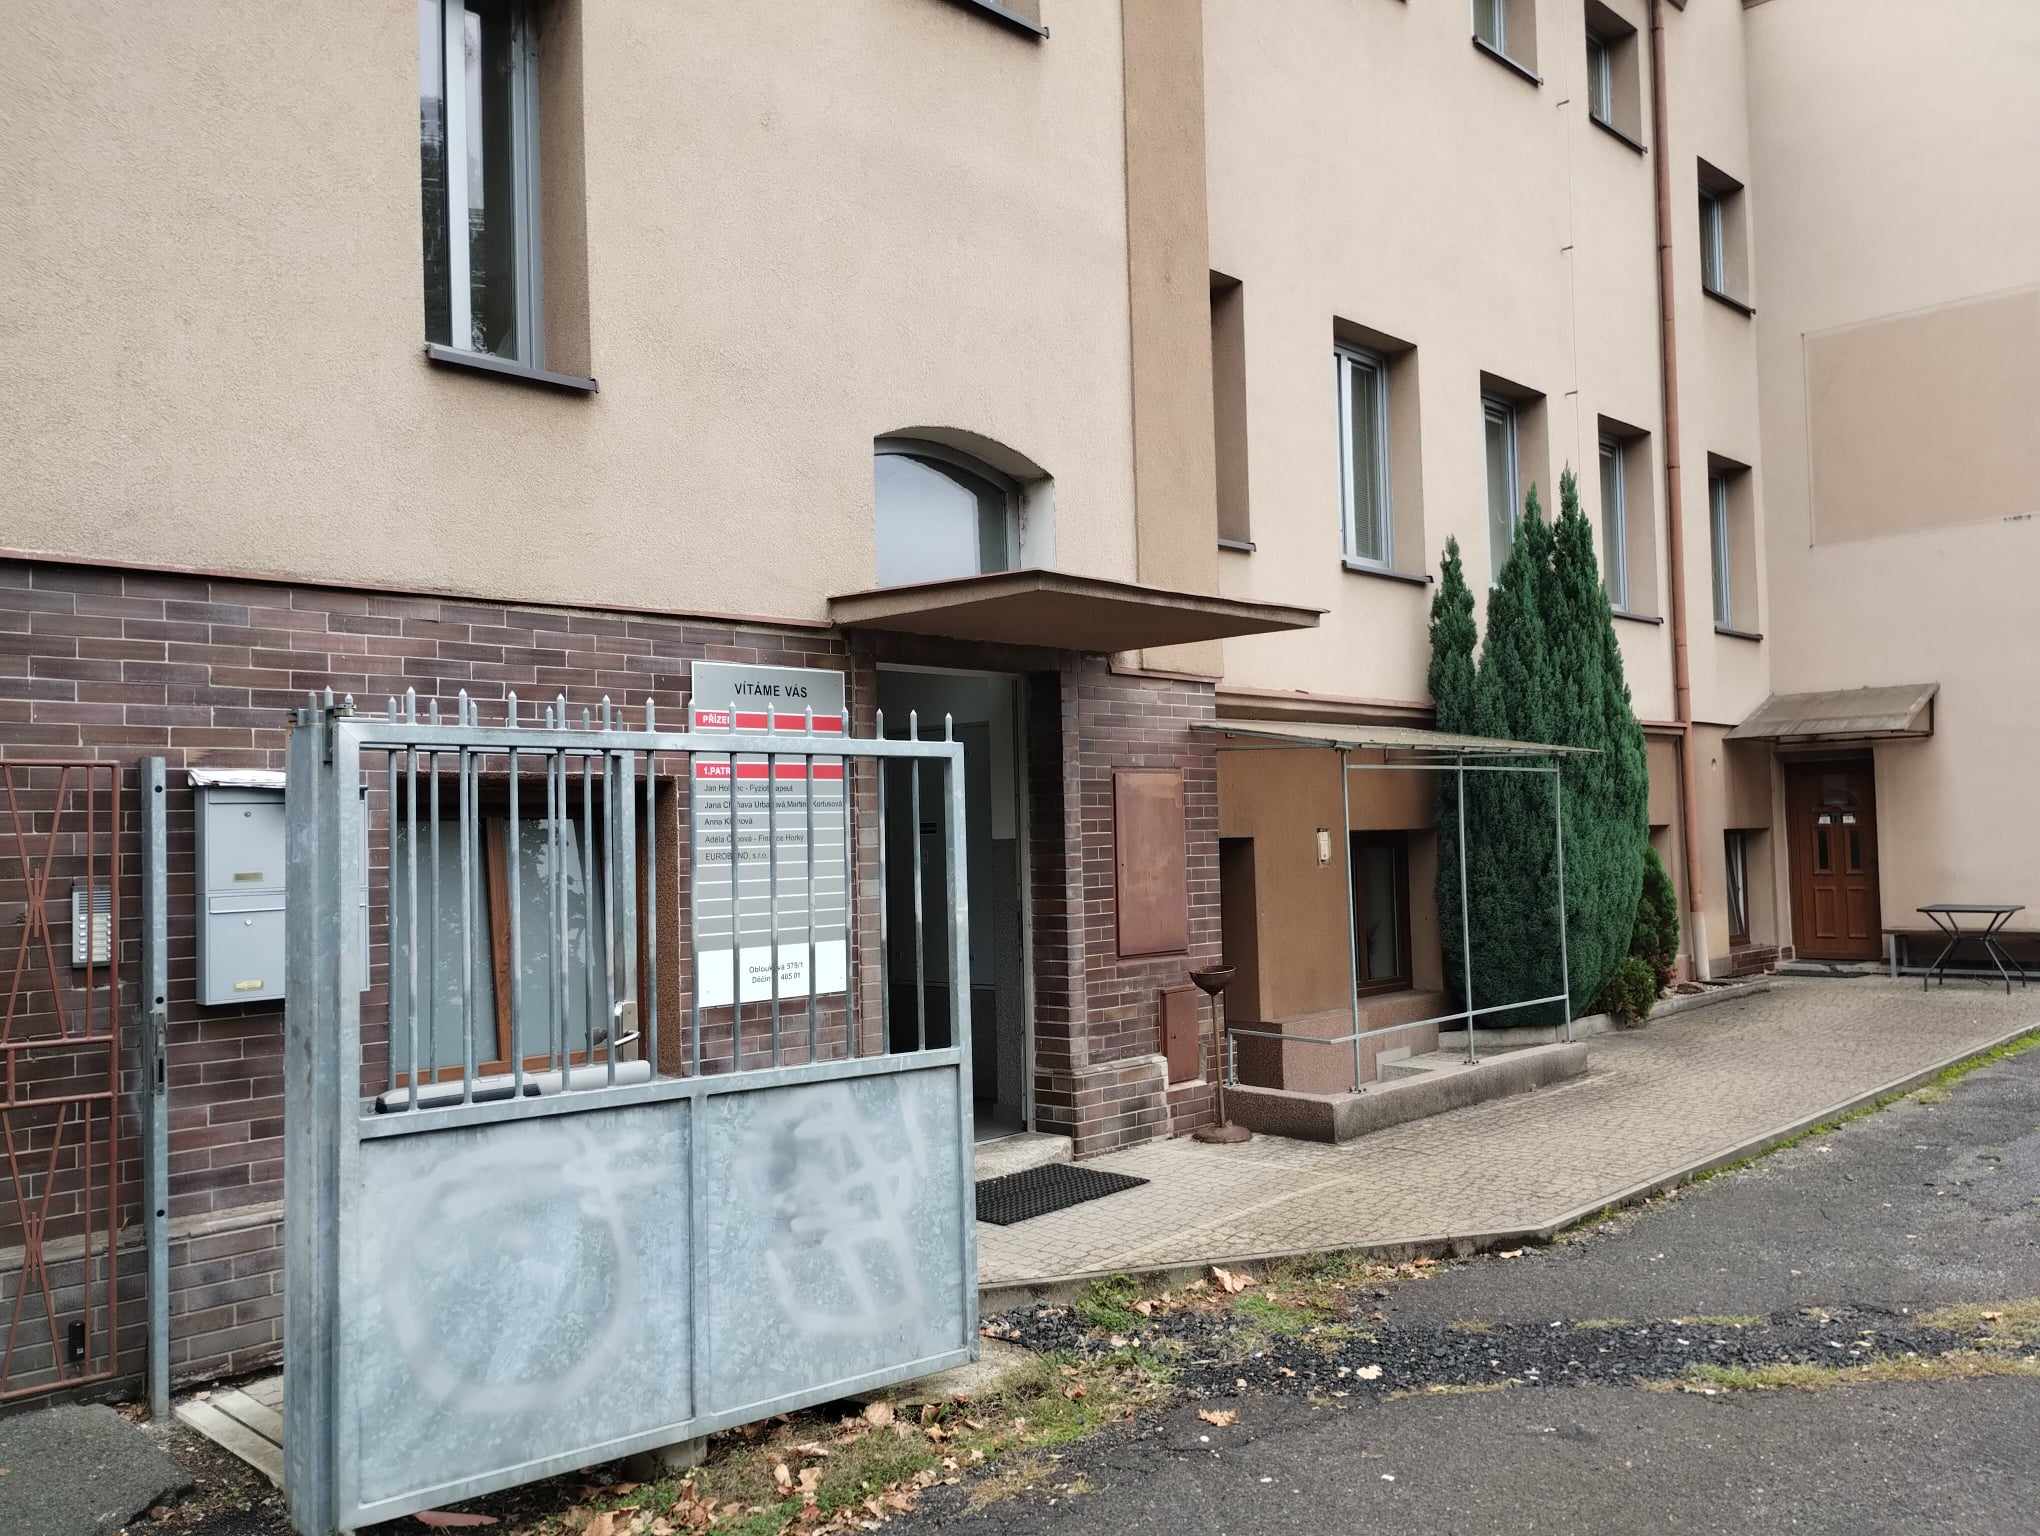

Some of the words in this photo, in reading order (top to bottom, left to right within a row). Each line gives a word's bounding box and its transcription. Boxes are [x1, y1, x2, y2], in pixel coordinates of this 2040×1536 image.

[734, 680, 780, 697] VÍTÁME
[784, 683, 808, 698] VÁS
[702, 712, 730, 724] PŘÍZE
[703, 765, 730, 775] 1.PATR
[704, 817, 723, 826] Anna
